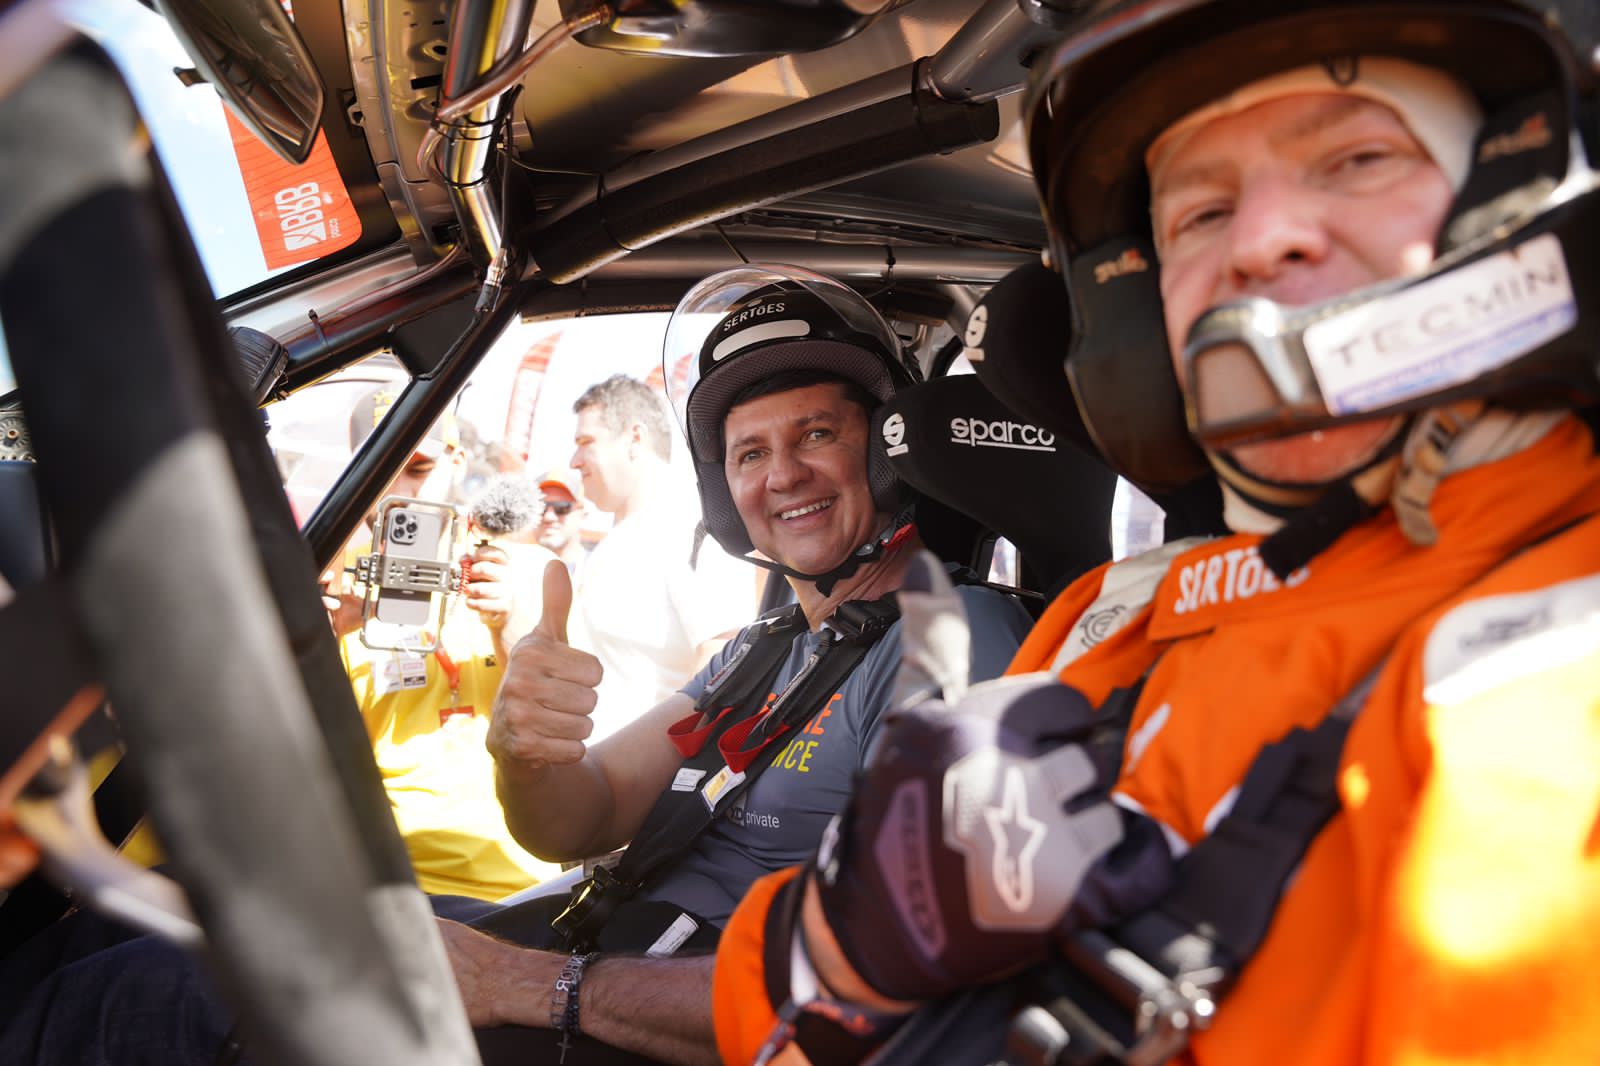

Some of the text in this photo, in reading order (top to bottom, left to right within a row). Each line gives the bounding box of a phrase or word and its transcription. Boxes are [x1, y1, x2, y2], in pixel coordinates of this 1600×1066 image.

[723, 302, 786, 332] SERTÕES
[1332, 263, 1559, 367] TECMIN
[950, 417, 1056, 449] sparco
[1173, 546, 1312, 614] SERTÕ
[746, 810, 780, 829] private
